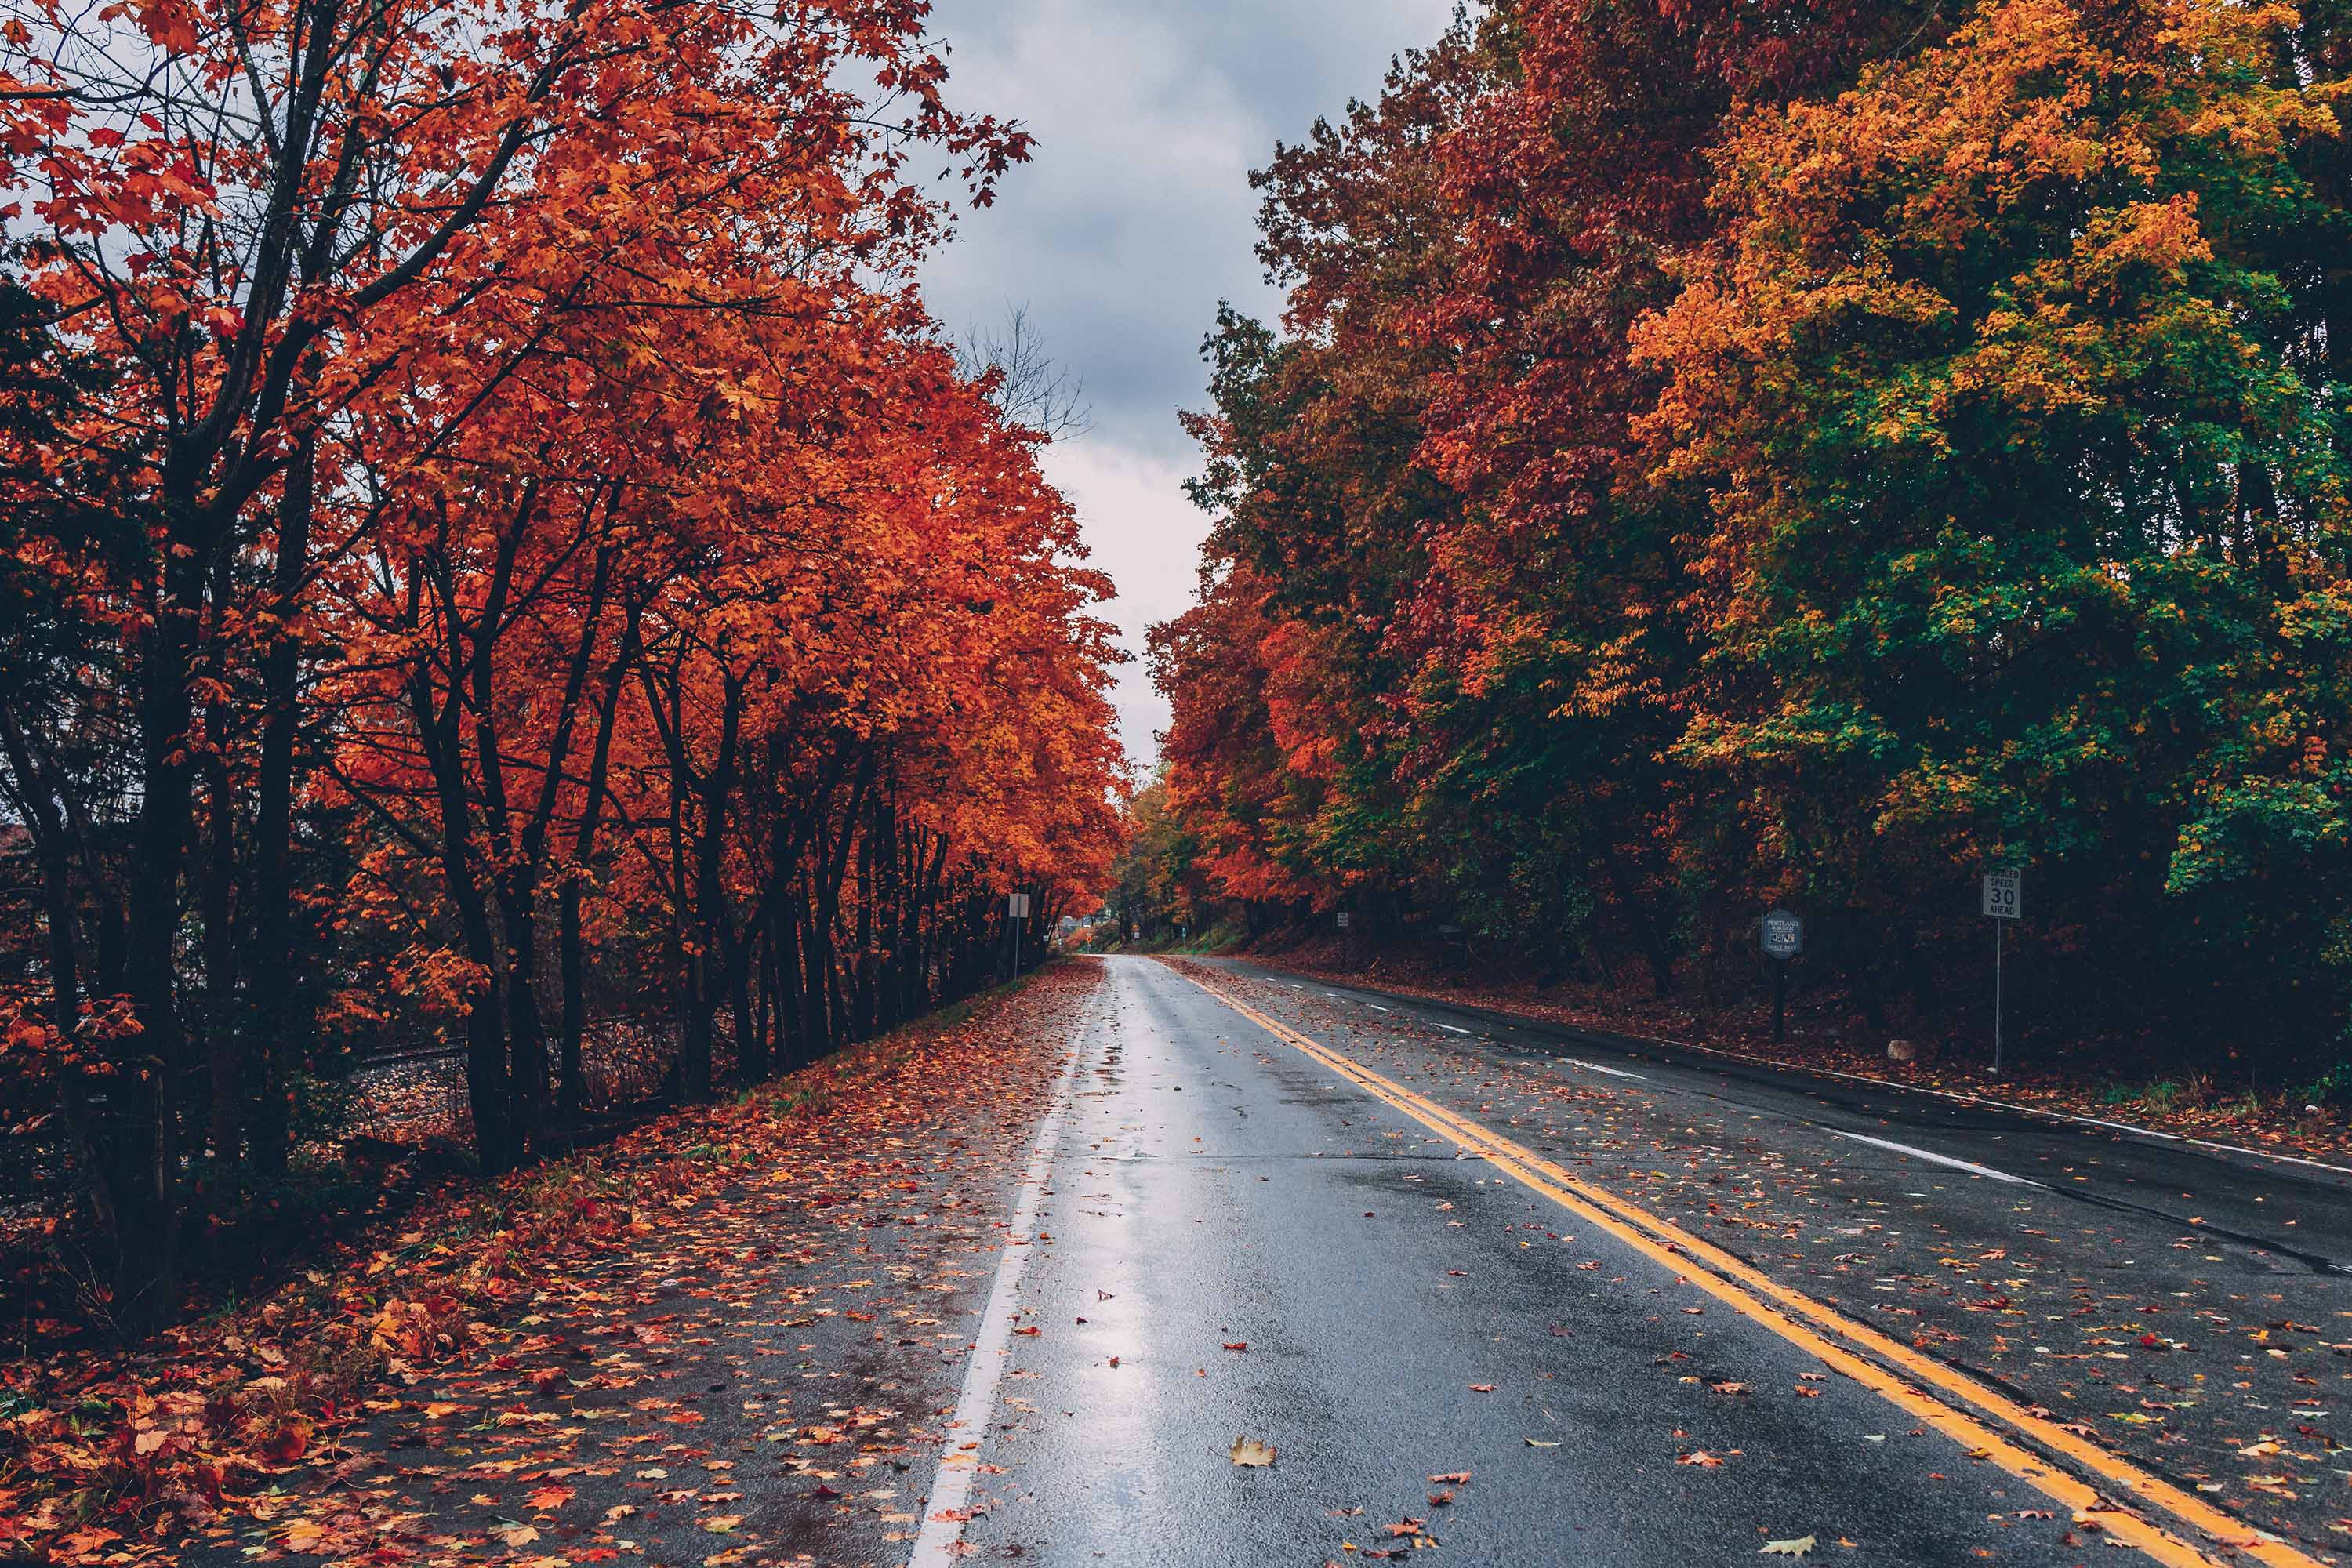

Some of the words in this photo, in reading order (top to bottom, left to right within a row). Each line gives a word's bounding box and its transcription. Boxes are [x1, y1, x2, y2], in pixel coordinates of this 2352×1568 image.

[1990, 877, 2014, 888] SPEED
[1991, 888, 2014, 905] 30
[1990, 905, 2014, 916] AHEAD
